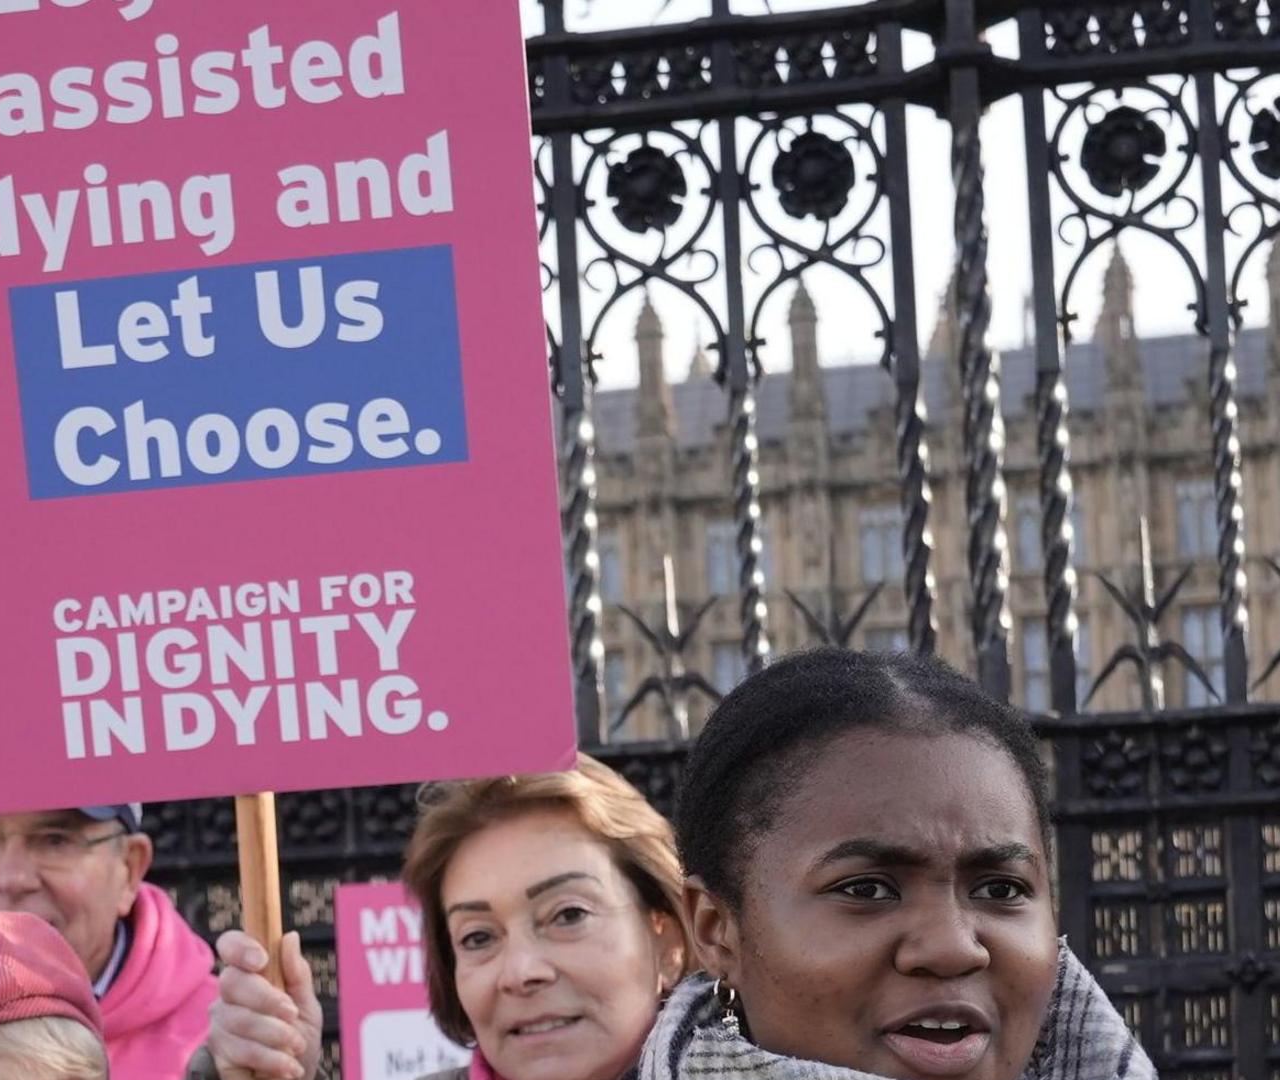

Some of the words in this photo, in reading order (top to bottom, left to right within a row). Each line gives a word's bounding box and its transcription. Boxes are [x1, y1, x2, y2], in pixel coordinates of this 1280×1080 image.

[275, 129, 455, 229] and
[53, 276, 216, 370] Let
[254, 264, 385, 349] Us
[52, 397, 443, 486] Choose.
[52, 580, 302, 634] CAMPAIGN
[318, 569, 416, 612] FOR
[55, 608, 417, 698] DIGNITY
[61, 695, 147, 760] IN
[161, 673, 450, 752] DYING.
